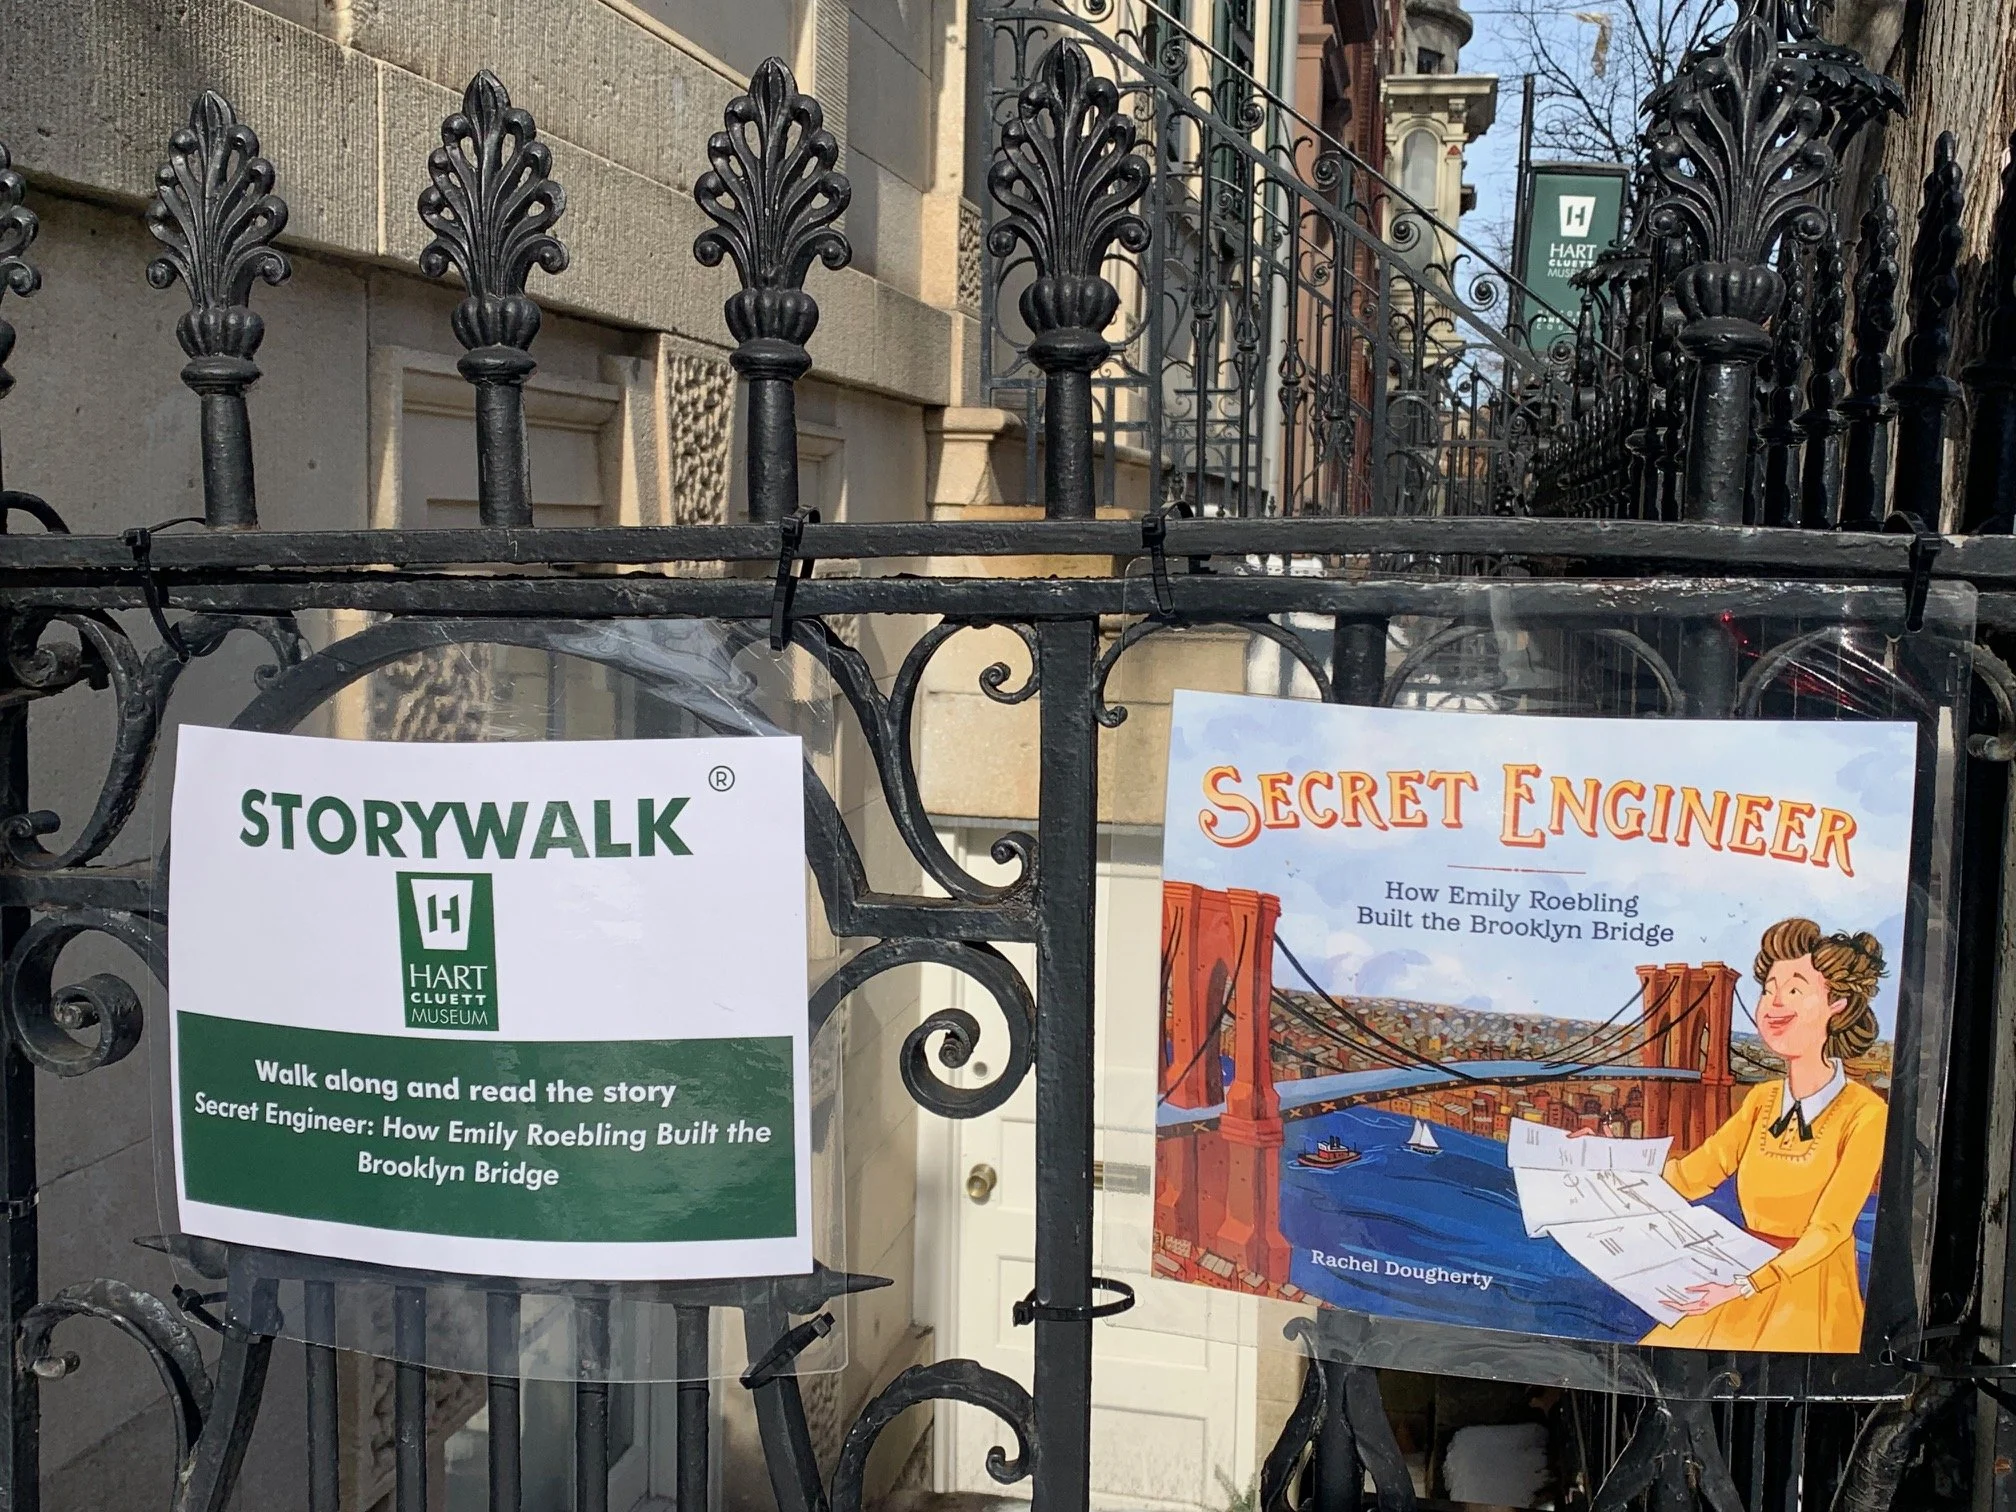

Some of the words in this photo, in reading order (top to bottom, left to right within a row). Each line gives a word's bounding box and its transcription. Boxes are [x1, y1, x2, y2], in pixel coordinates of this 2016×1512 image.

[1548, 259, 1594, 268] CLUETT
[1549, 243, 1597, 260] HART
[239, 788, 694, 860] STORYWALK
[1199, 766, 1477, 848] SECRET
[1500, 764, 1857, 877] ENGINEER
[1384, 880, 1440, 903] How
[1448, 885, 1521, 913] Emily
[1528, 890, 1640, 919] Roebling
[1356, 905, 1414, 929] Built
[1421, 911, 1461, 932] the
[1469, 914, 1583, 943] Brooklyn
[1591, 919, 1674, 947] Bridge
[409, 963, 488, 990] HART
[410, 992, 487, 1006] CLUETT
[411, 1007, 489, 1026] MUSEUM
[254, 1059, 318, 1089] Walk
[324, 1068, 399, 1102] along
[406, 1076, 460, 1100] and
[469, 1078, 537, 1103] read
[545, 1079, 594, 1103] the
[603, 1081, 677, 1108] story
[194, 1091, 260, 1121] Secret
[265, 1102, 374, 1136] Engineer:
[382, 1115, 441, 1141] How
[448, 1120, 519, 1151] Emily
[526, 1122, 647, 1152] Roebling
[656, 1120, 719, 1146] Built
[726, 1120, 772, 1144] the
[358, 1150, 465, 1186] Brooklyn
[474, 1160, 560, 1191] Bridge
[1311, 1249, 1379, 1274] Rachel
[1384, 1260, 1494, 1291] Dougherty
